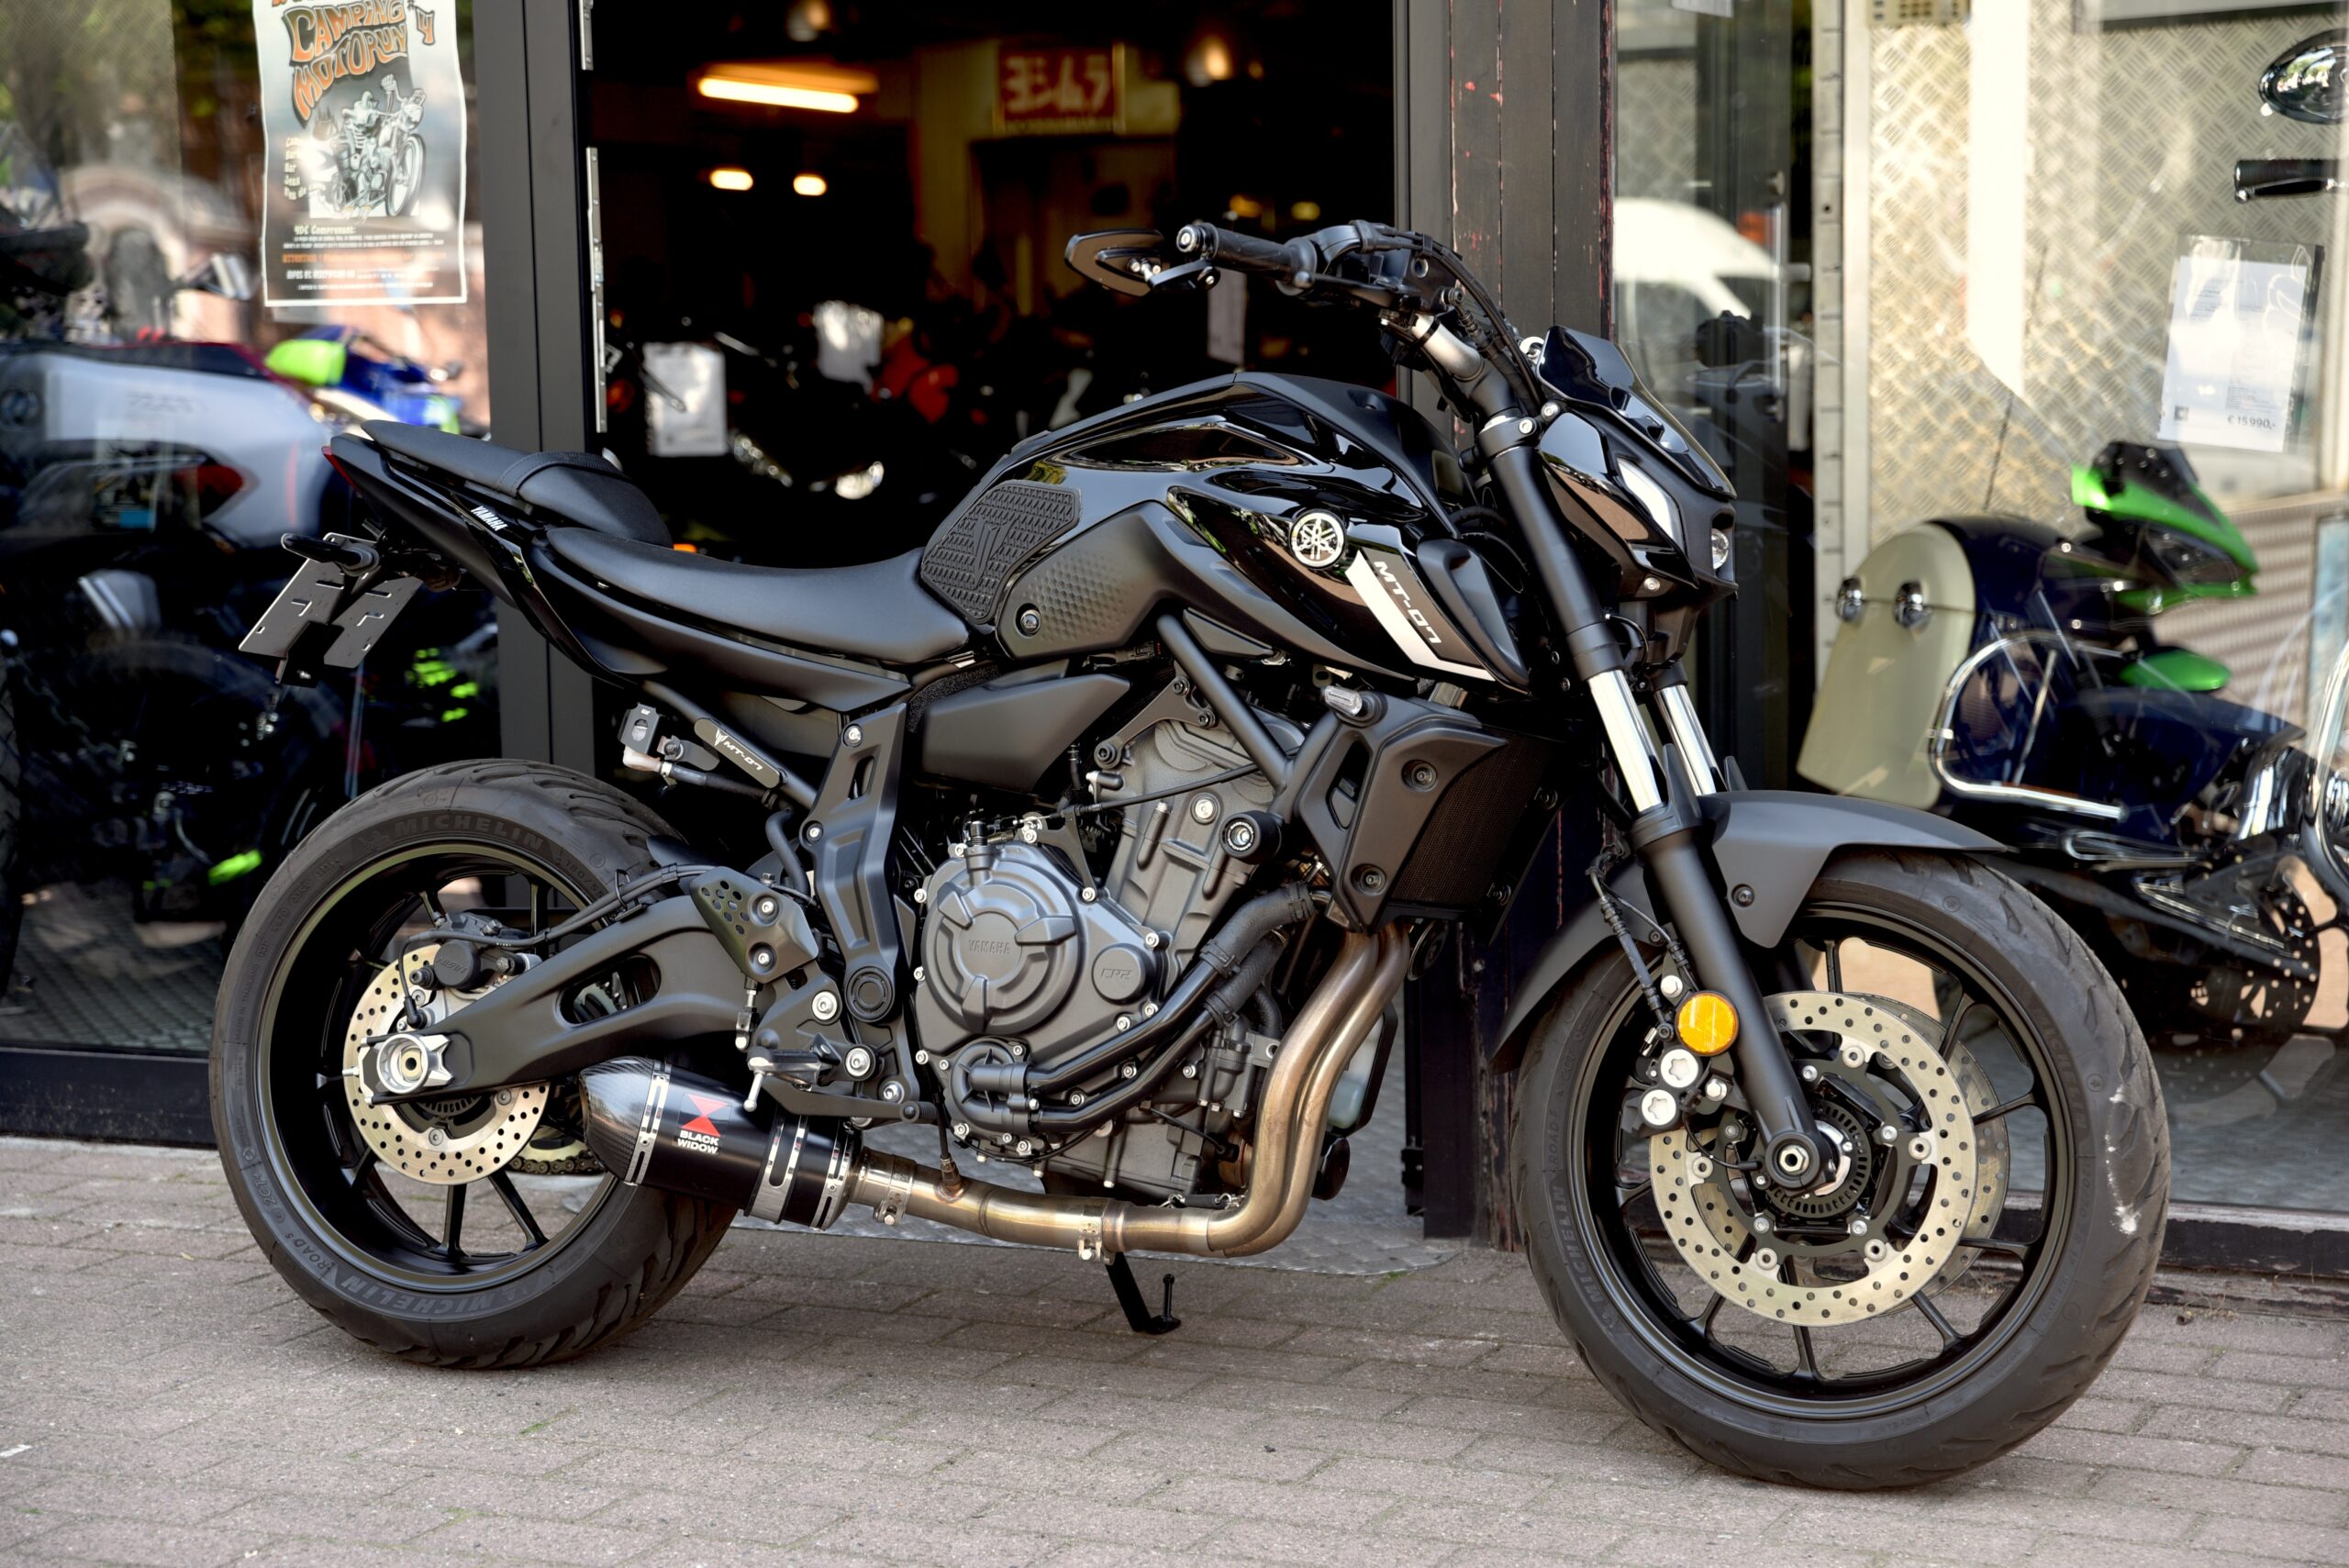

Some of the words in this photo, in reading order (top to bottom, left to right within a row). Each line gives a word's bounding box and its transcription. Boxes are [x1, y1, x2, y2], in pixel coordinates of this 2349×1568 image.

[284, 0, 406, 62] CAMPING
[293, 23, 409, 121] MOTORUN
[1374, 561, 1442, 644] MT-07
[723, 740, 763, 771] MT-07
[395, 812, 544, 851] MICHELIN
[969, 939, 1011, 955] YAMAHA
[2033, 1007, 2088, 1129] MICHELIN
[677, 1138, 718, 1154] WIDOW
[679, 1129, 719, 1146] BLACK
[1549, 1121, 1560, 1166] ROAD
[295, 1239, 331, 1273] ROAD
[1553, 1184, 1606, 1304] MICHELIN
[340, 1274, 496, 1315] MICHELIN
